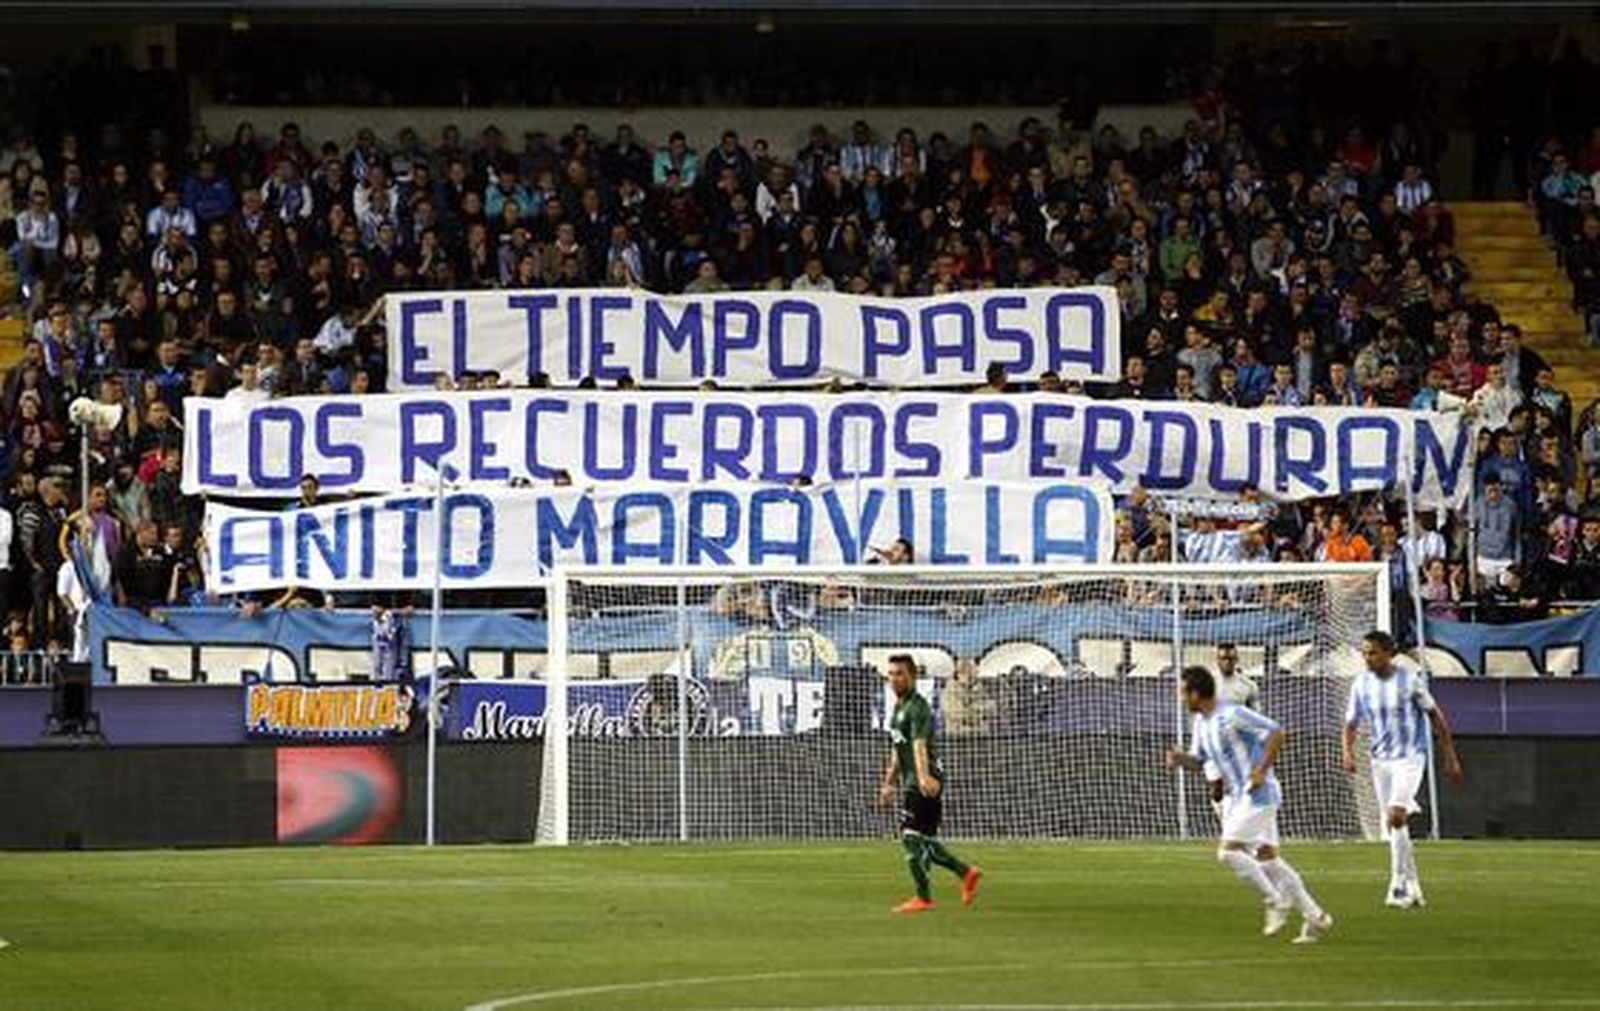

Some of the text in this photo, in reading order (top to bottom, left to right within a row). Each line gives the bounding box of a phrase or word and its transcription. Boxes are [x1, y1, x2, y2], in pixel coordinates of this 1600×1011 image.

[401, 293, 1105, 386] EL TIEMPO PASA
[197, 397, 1471, 497] LOS RECUERDOS PERDURAN
[219, 485, 1100, 583] ANITO MARAVILLA
